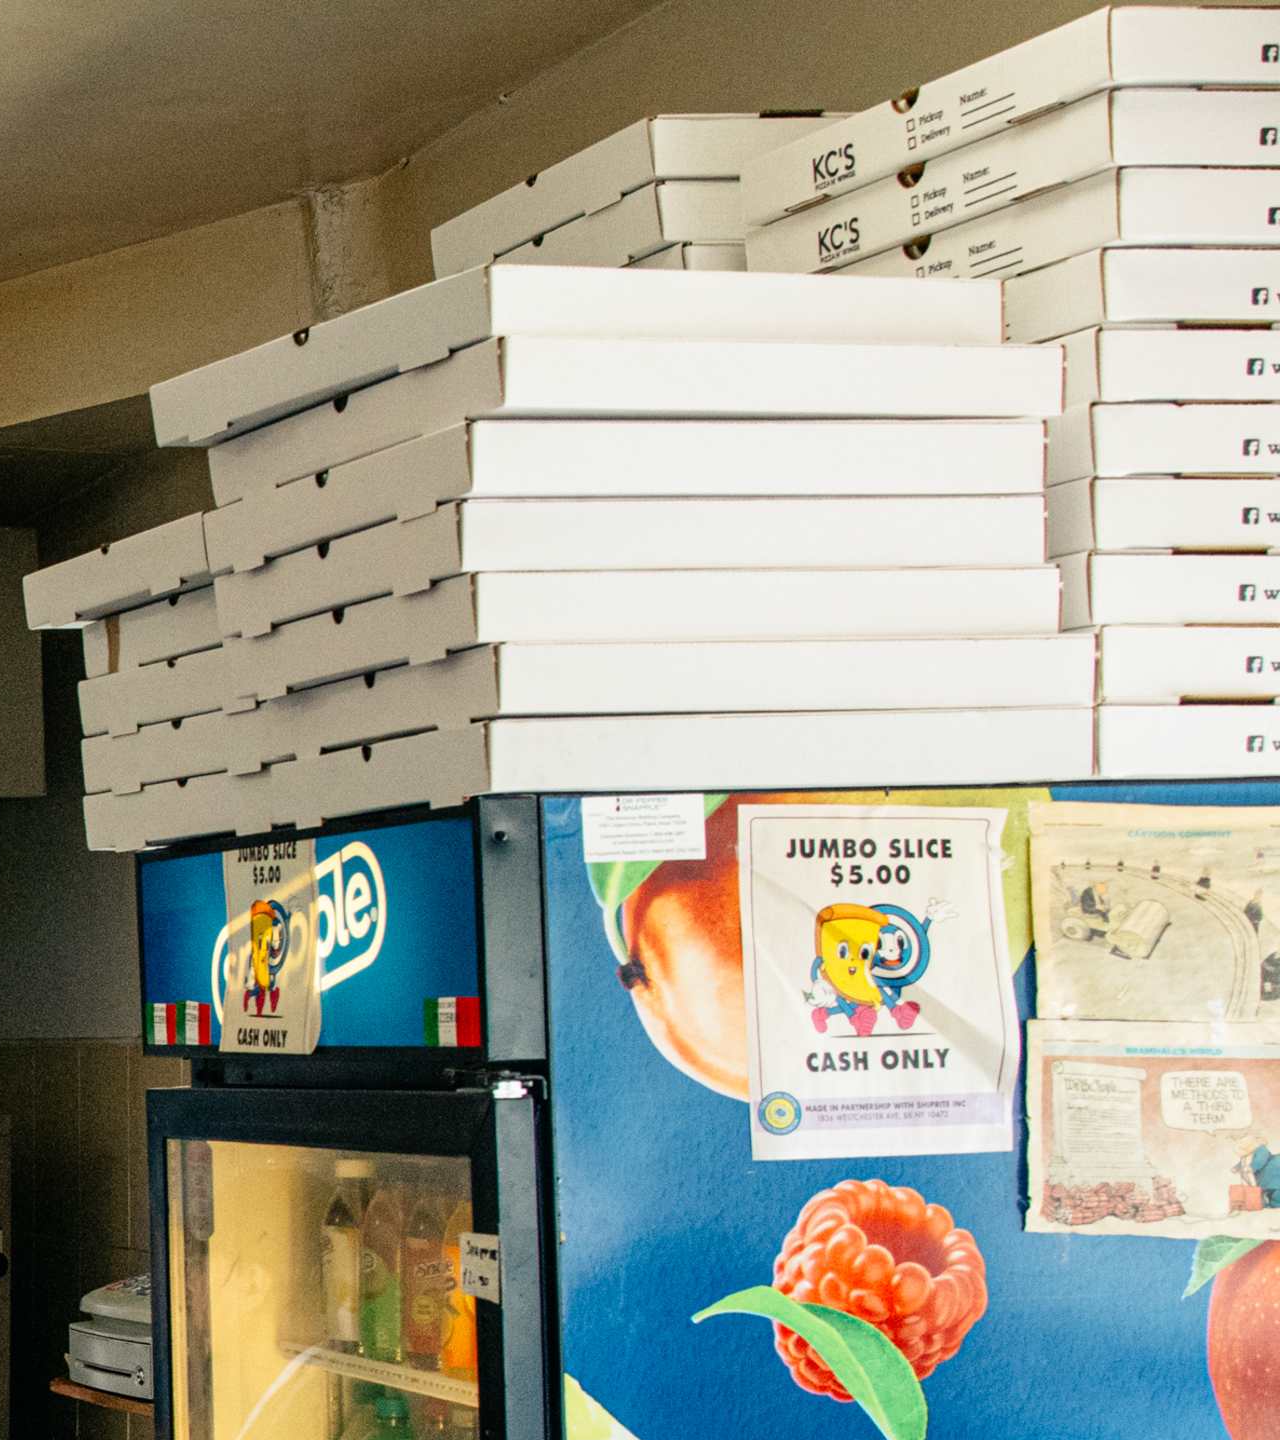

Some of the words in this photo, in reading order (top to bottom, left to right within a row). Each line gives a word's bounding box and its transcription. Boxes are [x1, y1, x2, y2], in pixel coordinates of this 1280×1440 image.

[959, 88, 988, 105] Name:
[918, 110, 944, 125] Pickup
[920, 125, 951, 144] Delivery
[812, 143, 856, 182] KC'S
[962, 166, 990, 184] Name:
[922, 187, 947, 202] Pickup
[924, 202, 954, 221] Delivery
[818, 217, 860, 256] KC'S
[968, 240, 997, 256] Name:
[927, 259, 953, 275] Pickup
[238, 844, 270, 862] JUMBO
[273, 841, 297, 861] SLICE
[787, 838, 876, 859] JUMBO
[889, 838, 953, 858] SLICE
[253, 866, 281, 884] $5.00
[830, 865, 911, 886] $5.00
[236, 1026, 262, 1047] CASH
[263, 1028, 288, 1048] ONLY
[806, 1052, 869, 1072] CASH
[881, 1048, 950, 1070] ONLY
